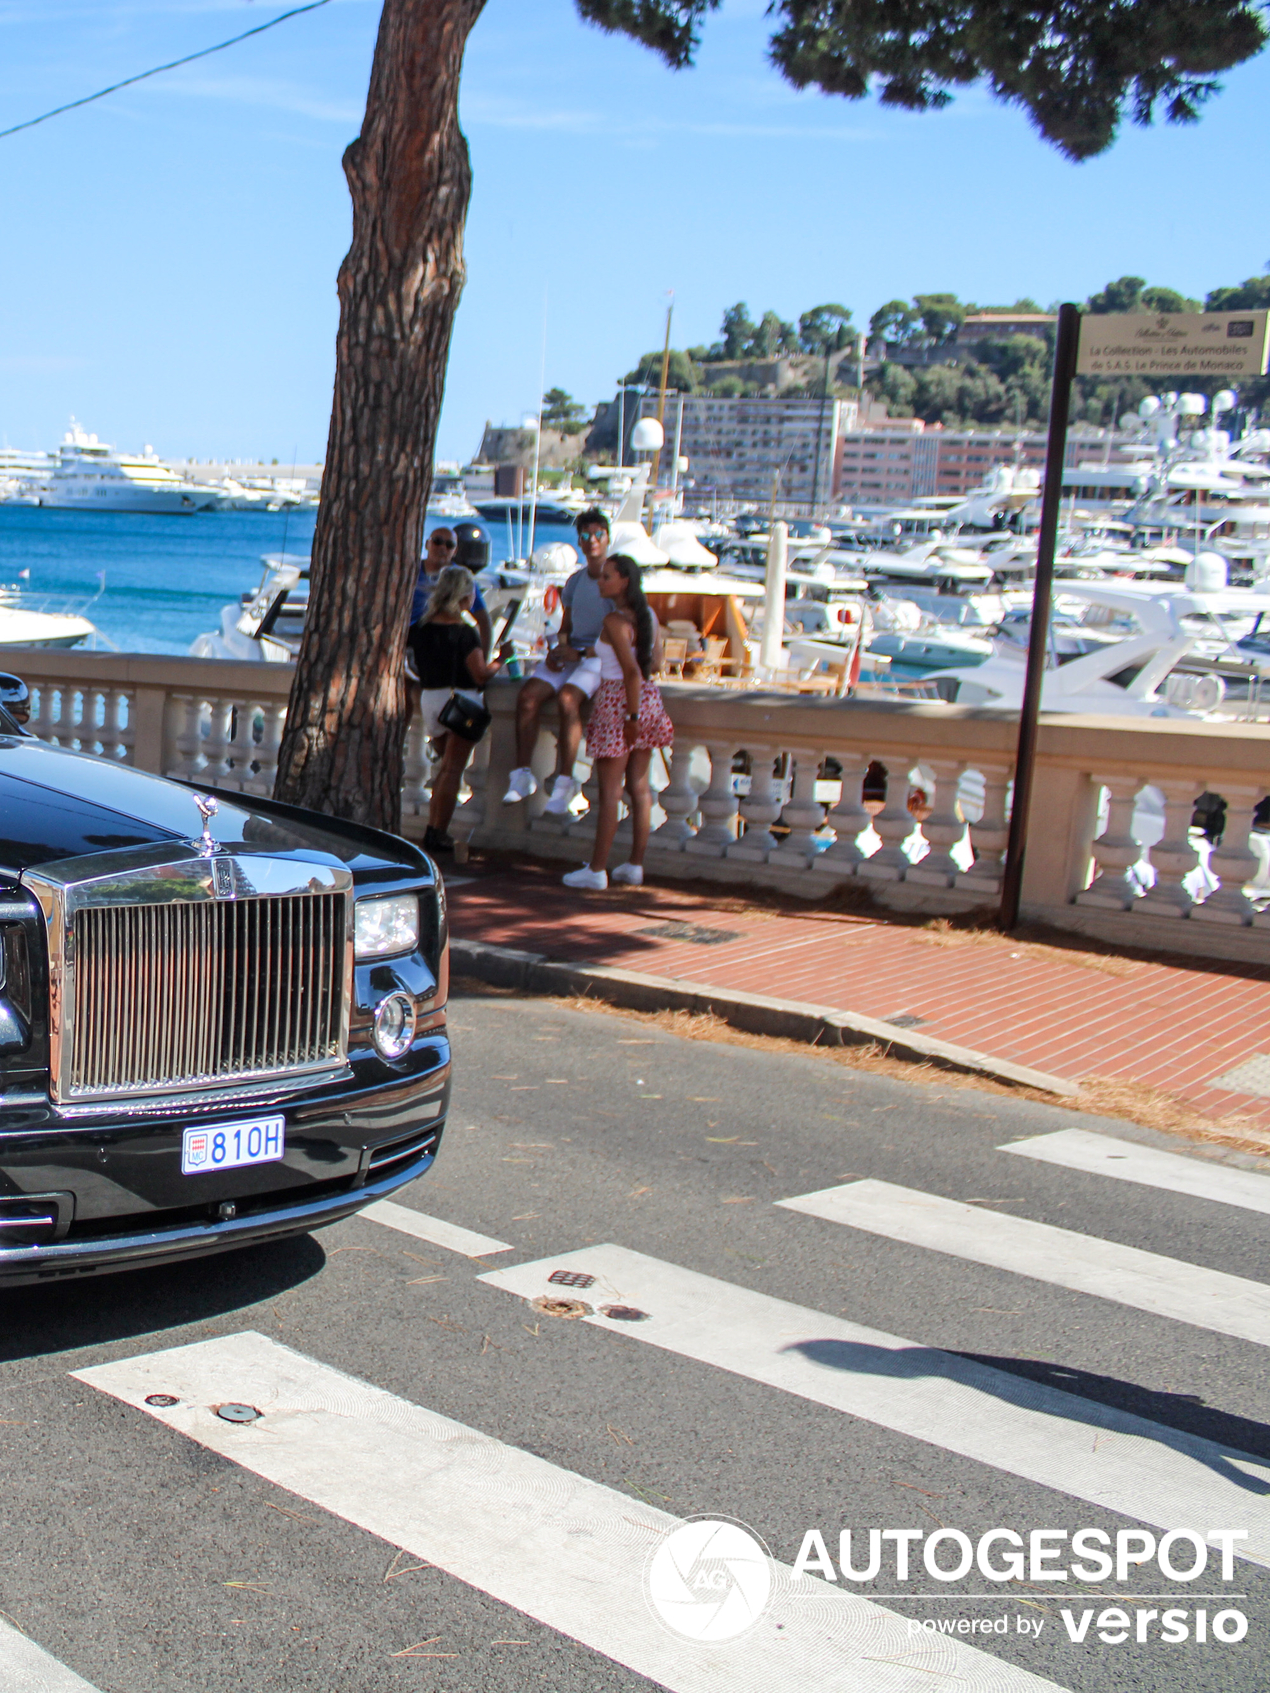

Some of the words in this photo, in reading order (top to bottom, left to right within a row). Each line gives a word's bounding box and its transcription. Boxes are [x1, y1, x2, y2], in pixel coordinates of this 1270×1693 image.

[1090, 345, 1101, 356] La
[1103, 345, 1153, 356] Collection
[1161, 345, 1177, 356] Les
[1180, 345, 1248, 355] Automobiles
[1091, 361, 1103, 370] de
[1136, 361, 1146, 370] Le
[1149, 360, 1181, 370] Prince
[1184, 361, 1197, 370] de
[1199, 361, 1244, 370] Monaco
[212, 1123, 279, 1163] 810H
[192, 1151, 204, 1160] MC
